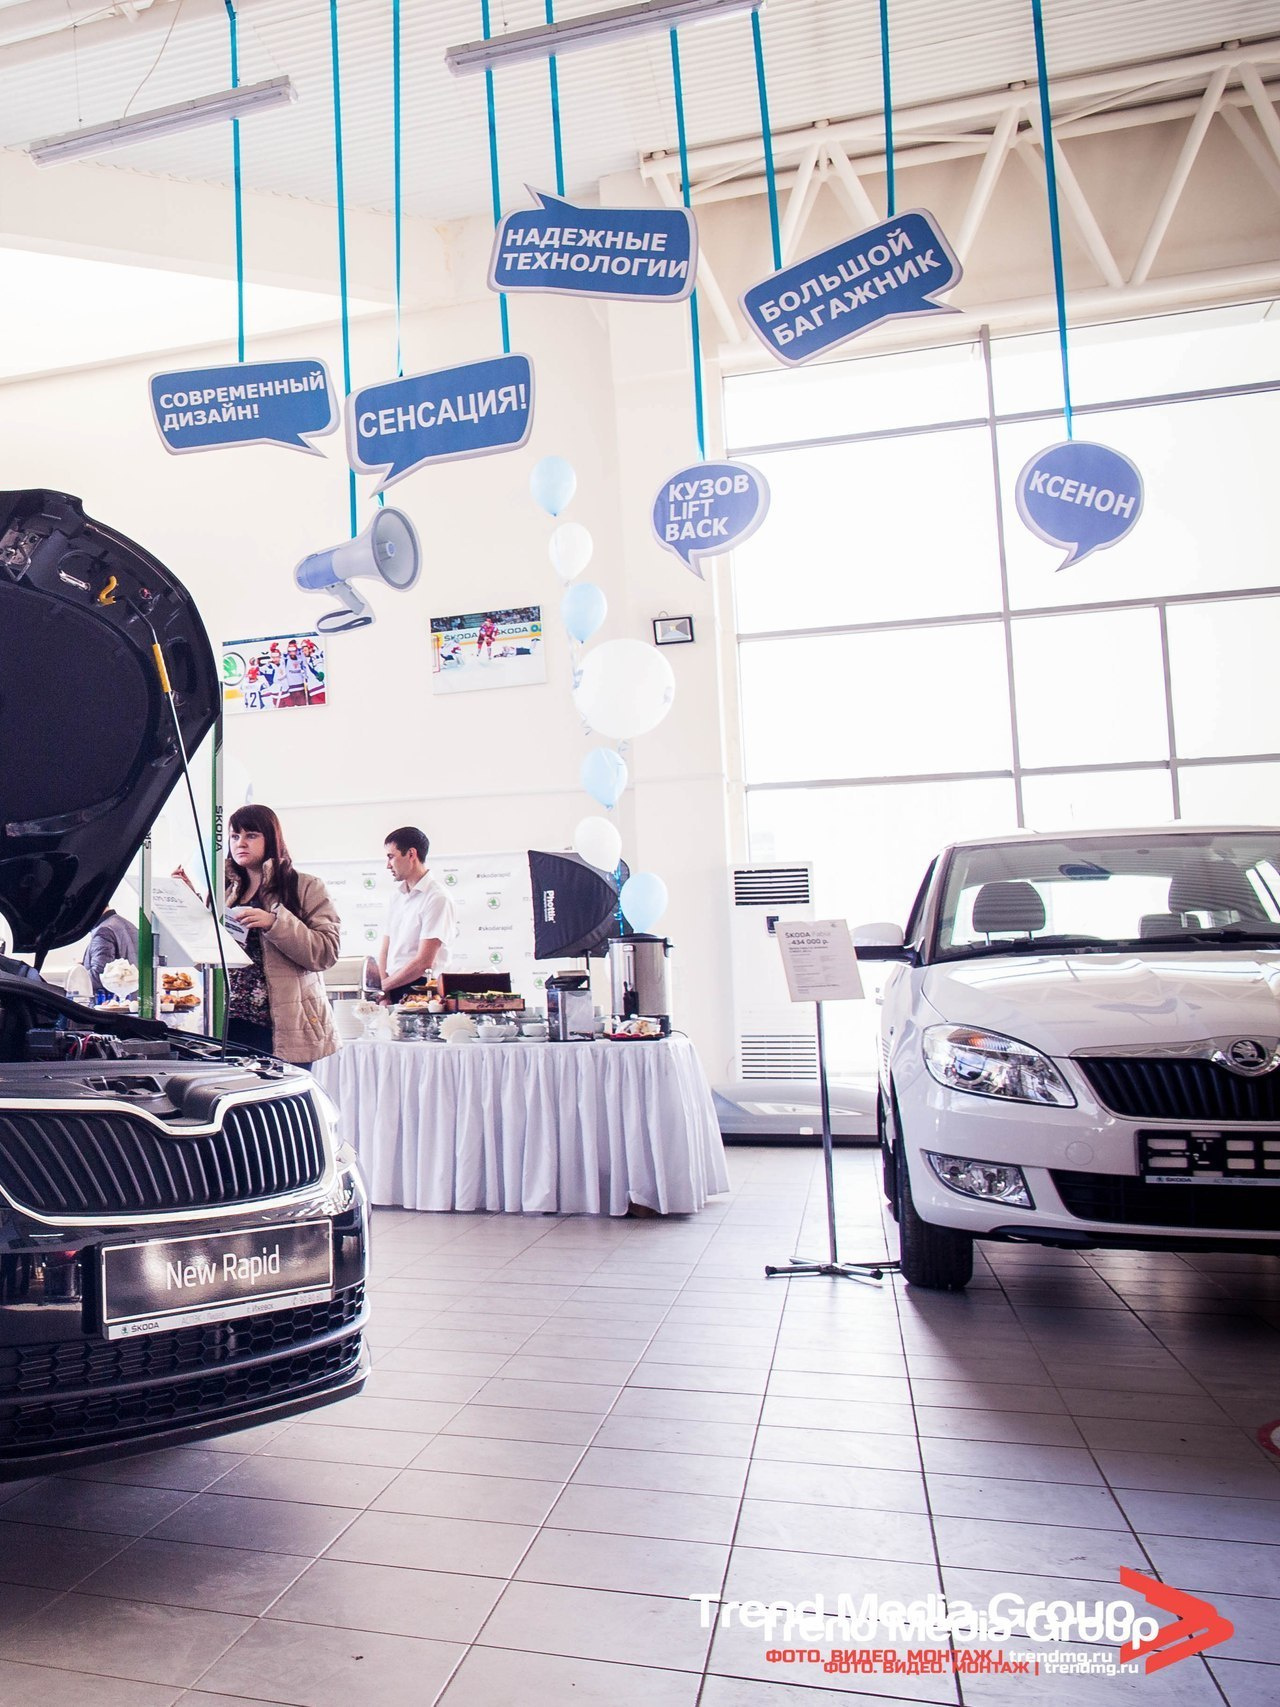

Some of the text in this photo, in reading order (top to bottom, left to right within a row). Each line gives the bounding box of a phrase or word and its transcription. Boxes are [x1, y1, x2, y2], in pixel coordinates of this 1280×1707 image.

[505, 227, 667, 252] НАДЕЖНЫЕ
[502, 252, 688, 280] ТЕХНОЛОГИИ
[758, 228, 914, 323] БОЛЬШОЙ
[773, 248, 942, 346] БАГАЖНИК
[159, 371, 325, 409] СОВРЕМЕННЫЙ
[163, 402, 260, 432] ДИЗАЙН!
[358, 383, 528, 438] СЕНСАЦИЯ!
[668, 474, 749, 502] КУЗОВ
[1028, 470, 1136, 519] КСЕНОН
[669, 499, 714, 522] LIFT
[665, 516, 729, 542] BACK
[166, 1244, 280, 1290] New Rapid
